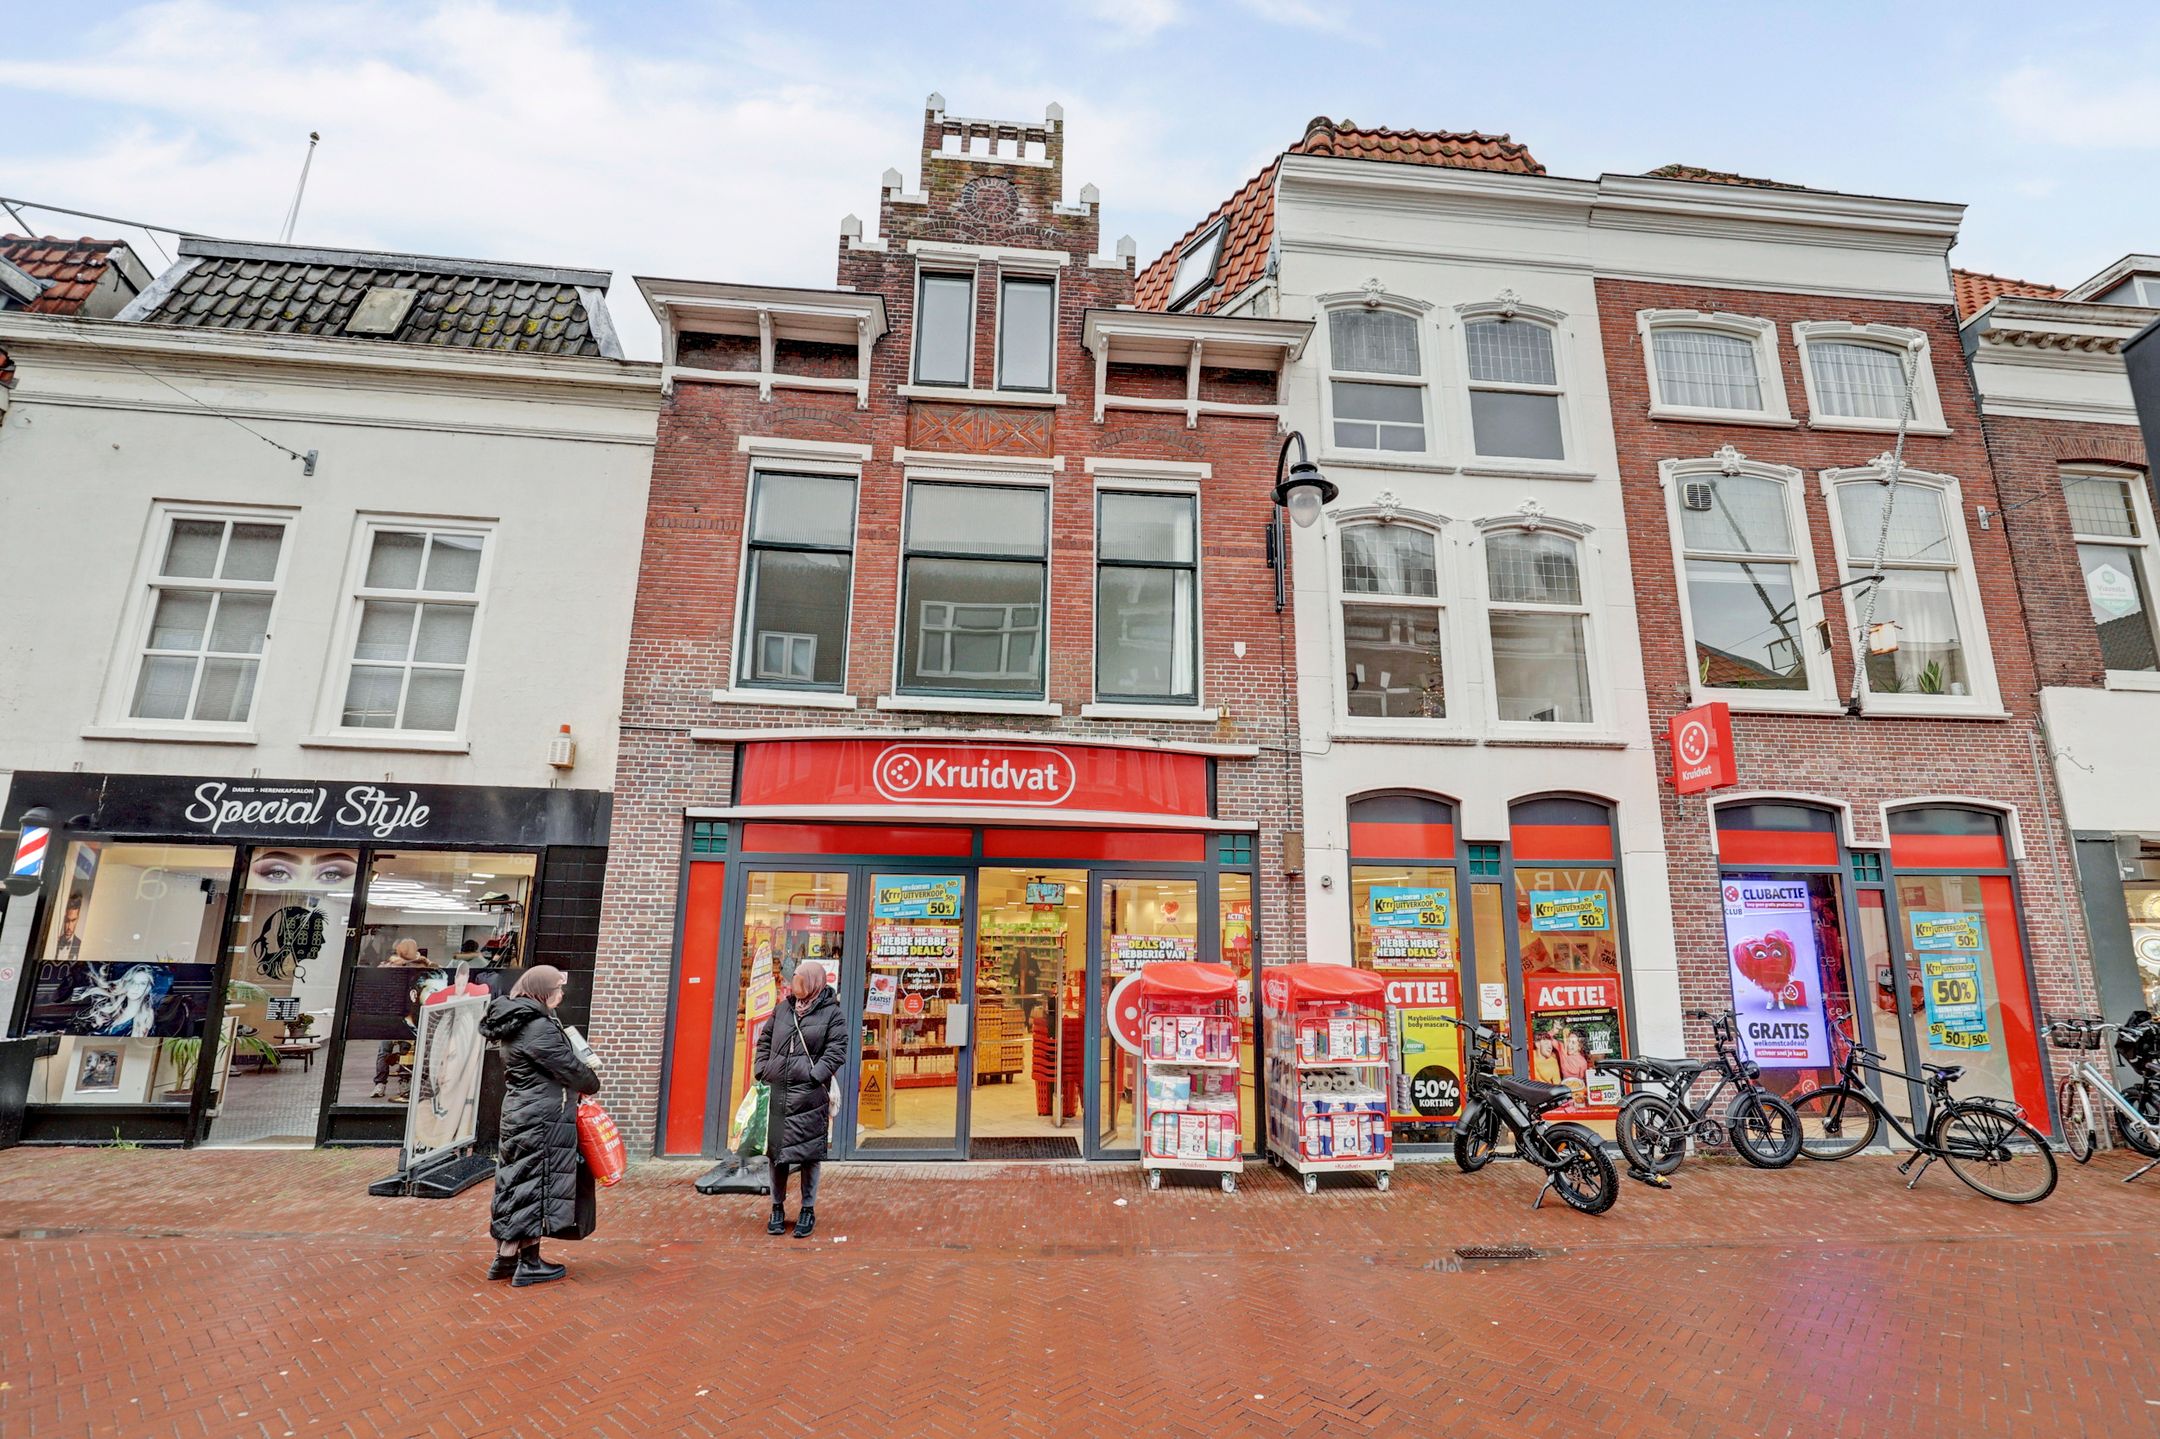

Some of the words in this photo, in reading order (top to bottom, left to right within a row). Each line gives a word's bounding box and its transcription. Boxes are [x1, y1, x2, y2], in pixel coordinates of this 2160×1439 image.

[925, 757, 1059, 791] Kruidvat
[1681, 765, 1712, 781] Kruidvat
[185, 782, 328, 834] Special
[336, 786, 430, 838] Style
[880, 889, 901, 903] Krrr
[903, 890, 944, 899] UITVERKOOP
[1743, 887, 1806, 900] CLUBACTIE
[930, 902, 951, 914] 50%
[1375, 899, 1393, 912] Krrr
[1395, 900, 1434, 909] UITVERKOOP
[1536, 904, 1554, 916] Krrr
[1555, 903, 1592, 912] UITVERKOOP
[1422, 913, 1441, 923] 50%
[1581, 915, 1601, 925] 50%
[1915, 924, 1932, 936] Krrr
[1934, 924, 1967, 932] UITVERKOOP
[881, 936, 914, 946] HEBBE
[914, 937, 947, 946] HEBBE
[1128, 940, 1160, 950] DEALS
[1159, 940, 1175, 950] OM
[1380, 939, 1410, 948] HEBBE
[1410, 940, 1440, 949] HEBBE
[1958, 936, 1975, 946] 50%
[876, 945, 909, 956] HEBBE
[910, 946, 943, 956] DEALS
[1118, 949, 1166, 959] HEBBERIG
[1166, 950, 1186, 959] VAN
[1376, 947, 1407, 957] HEBBE
[1407, 948, 1437, 957] DEALS
[1123, 959, 1136, 969] TE
[1925, 963, 1941, 975] Krrr
[1385, 981, 1448, 1004] CTIE!
[1538, 986, 1607, 1006] ACTIE!
[1937, 981, 1972, 1003] 50%
[1407, 1015, 1440, 1024] Maybelline
[1408, 1020, 1423, 1028] body
[1589, 1030, 1611, 1041] HAPPY
[1748, 1022, 1809, 1039] GRATIS
[1753, 1039, 1807, 1047] welkomstcadeau!
[1945, 1031, 1967, 1046] 50%
[1972, 1034, 1988, 1045] 50%
[1592, 1041, 1610, 1052] ITALY
[1414, 1079, 1460, 1098] 50%
[1419, 1098, 1454, 1107] KORTING
